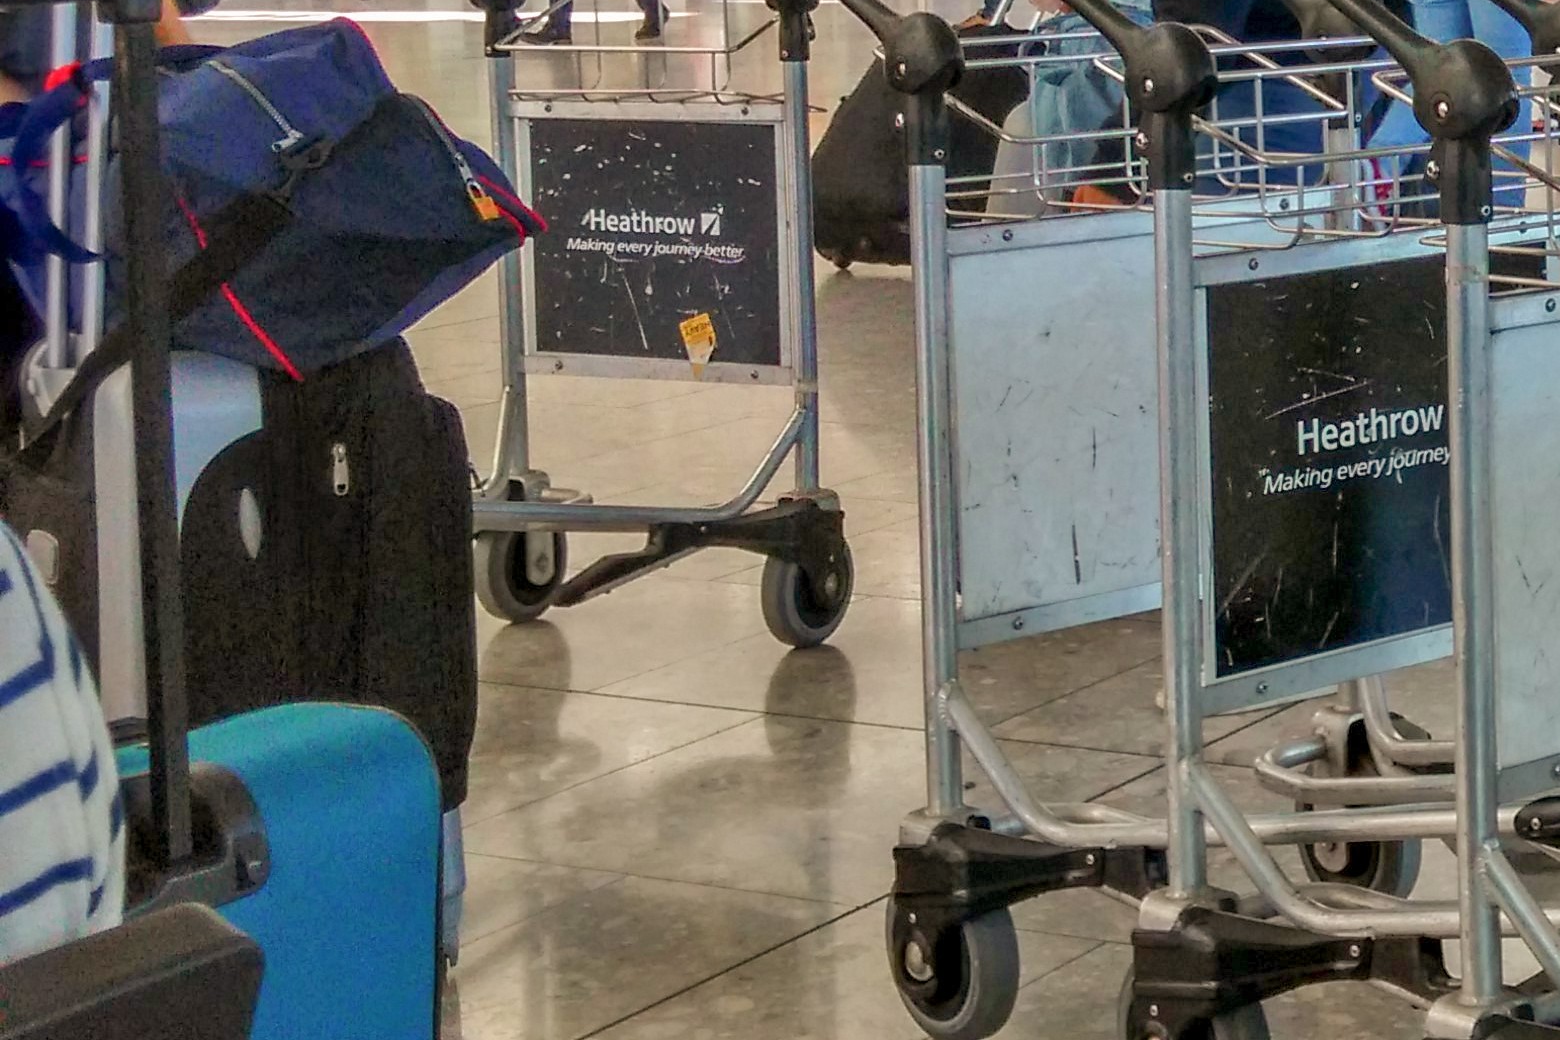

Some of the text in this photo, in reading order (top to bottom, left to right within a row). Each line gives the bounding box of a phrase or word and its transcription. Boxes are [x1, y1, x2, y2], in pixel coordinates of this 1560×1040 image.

[589, 208, 695, 236] Heathrow
[566, 237, 744, 259] Making every journey better
[1296, 403, 1445, 456] Heathrow
[1262, 445, 1450, 496] Making every journey
